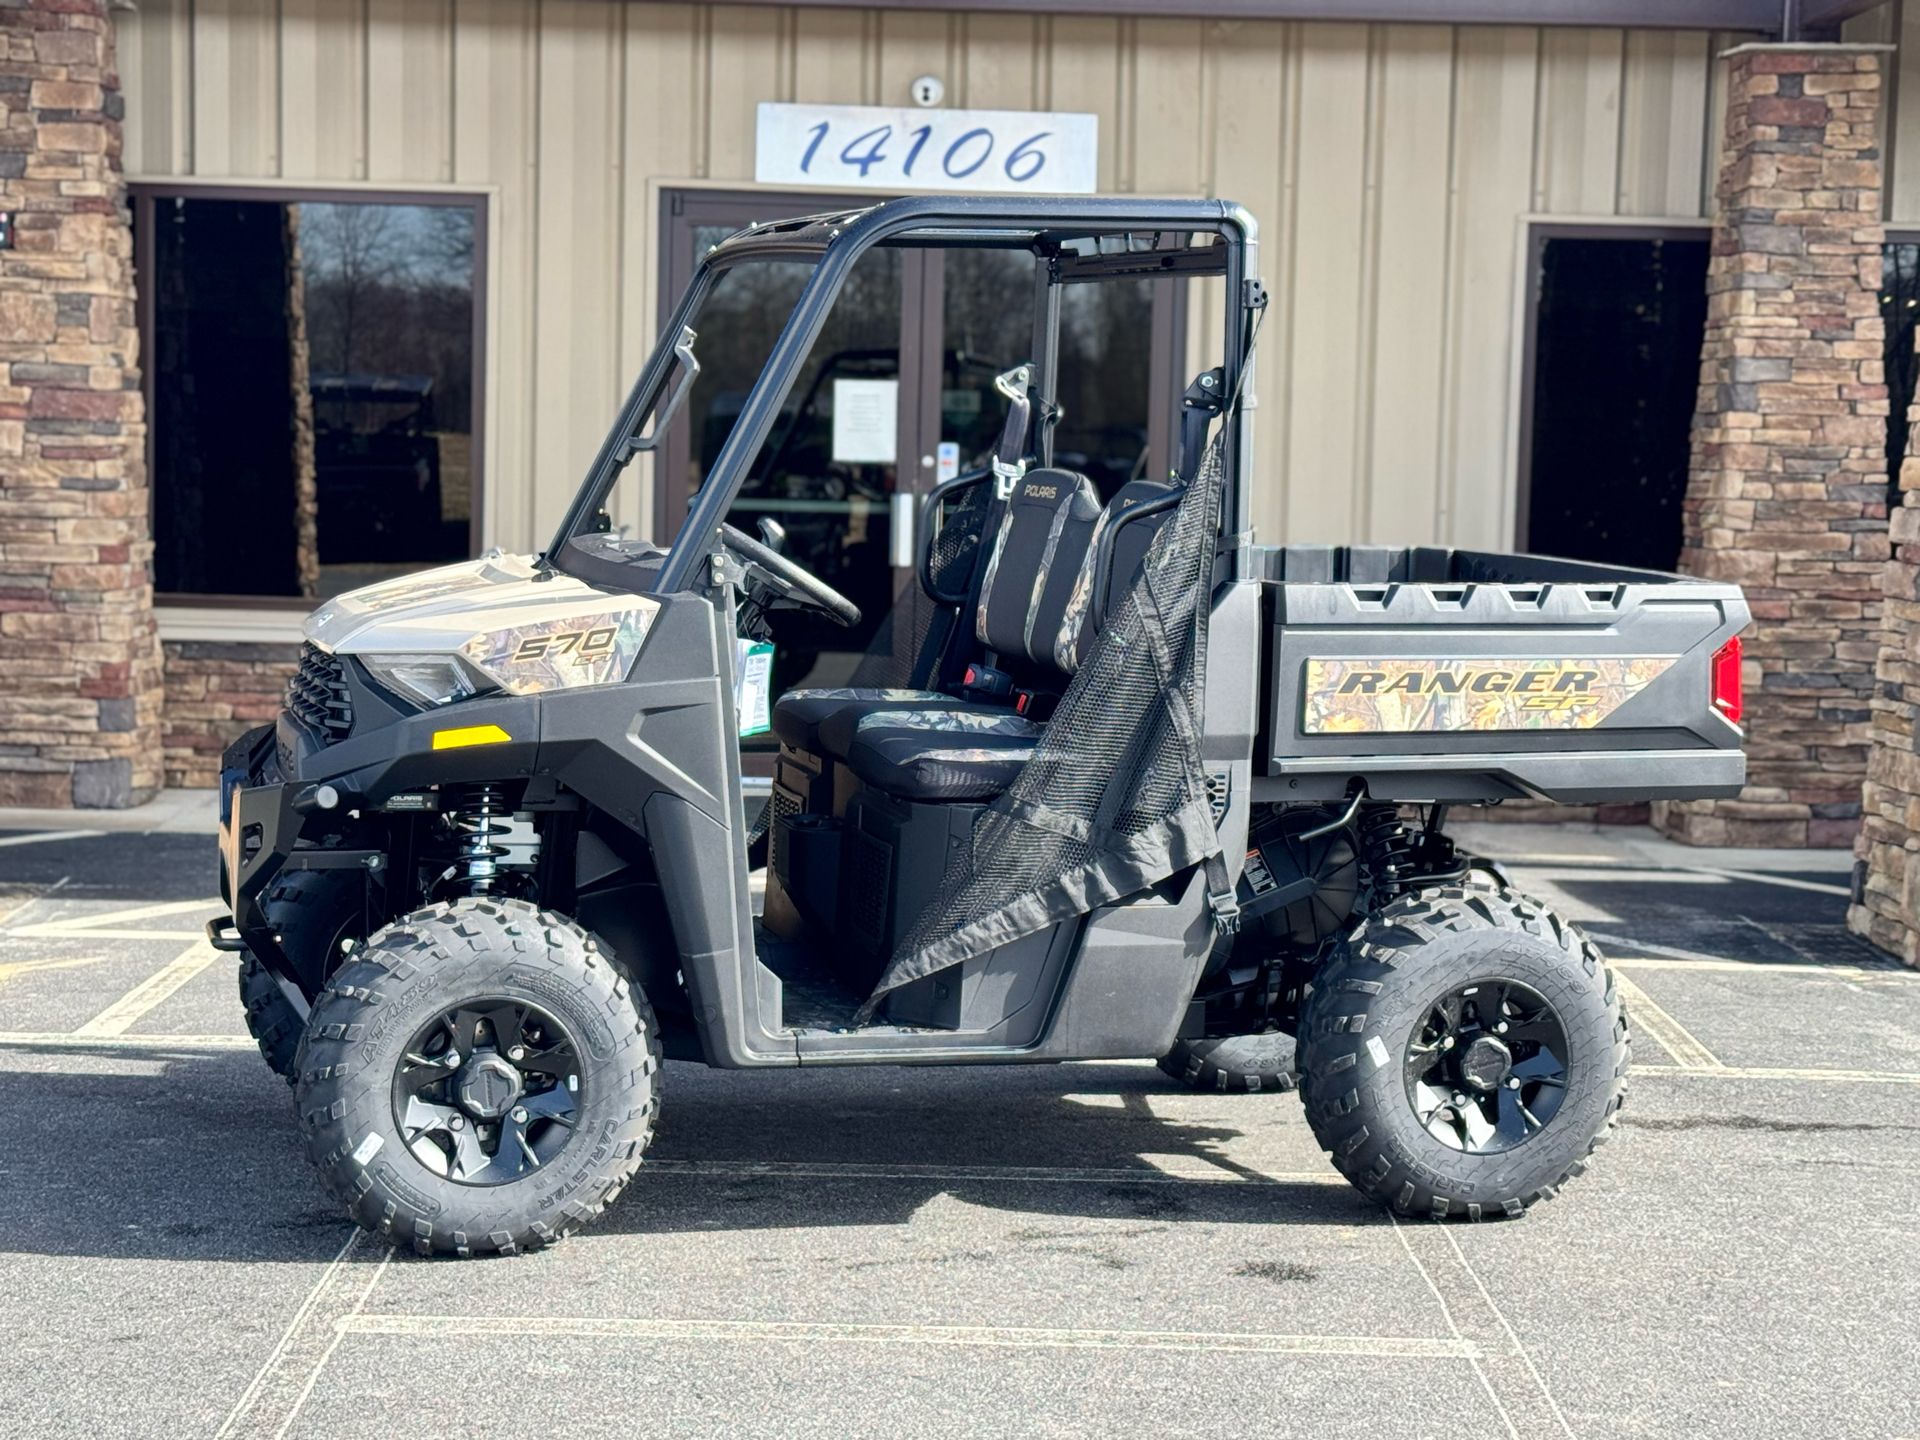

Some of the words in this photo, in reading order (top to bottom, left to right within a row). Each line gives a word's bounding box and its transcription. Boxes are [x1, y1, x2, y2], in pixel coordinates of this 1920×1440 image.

[800, 121, 1053, 182] 14106
[1023, 484, 1058, 499] POLARIS
[511, 625, 620, 663] 570
[572, 652, 613, 667] EFI
[1337, 669, 1601, 695] RANGER
[1518, 695, 1603, 711] SP
[536, 1117, 619, 1211] CARLSTAR
